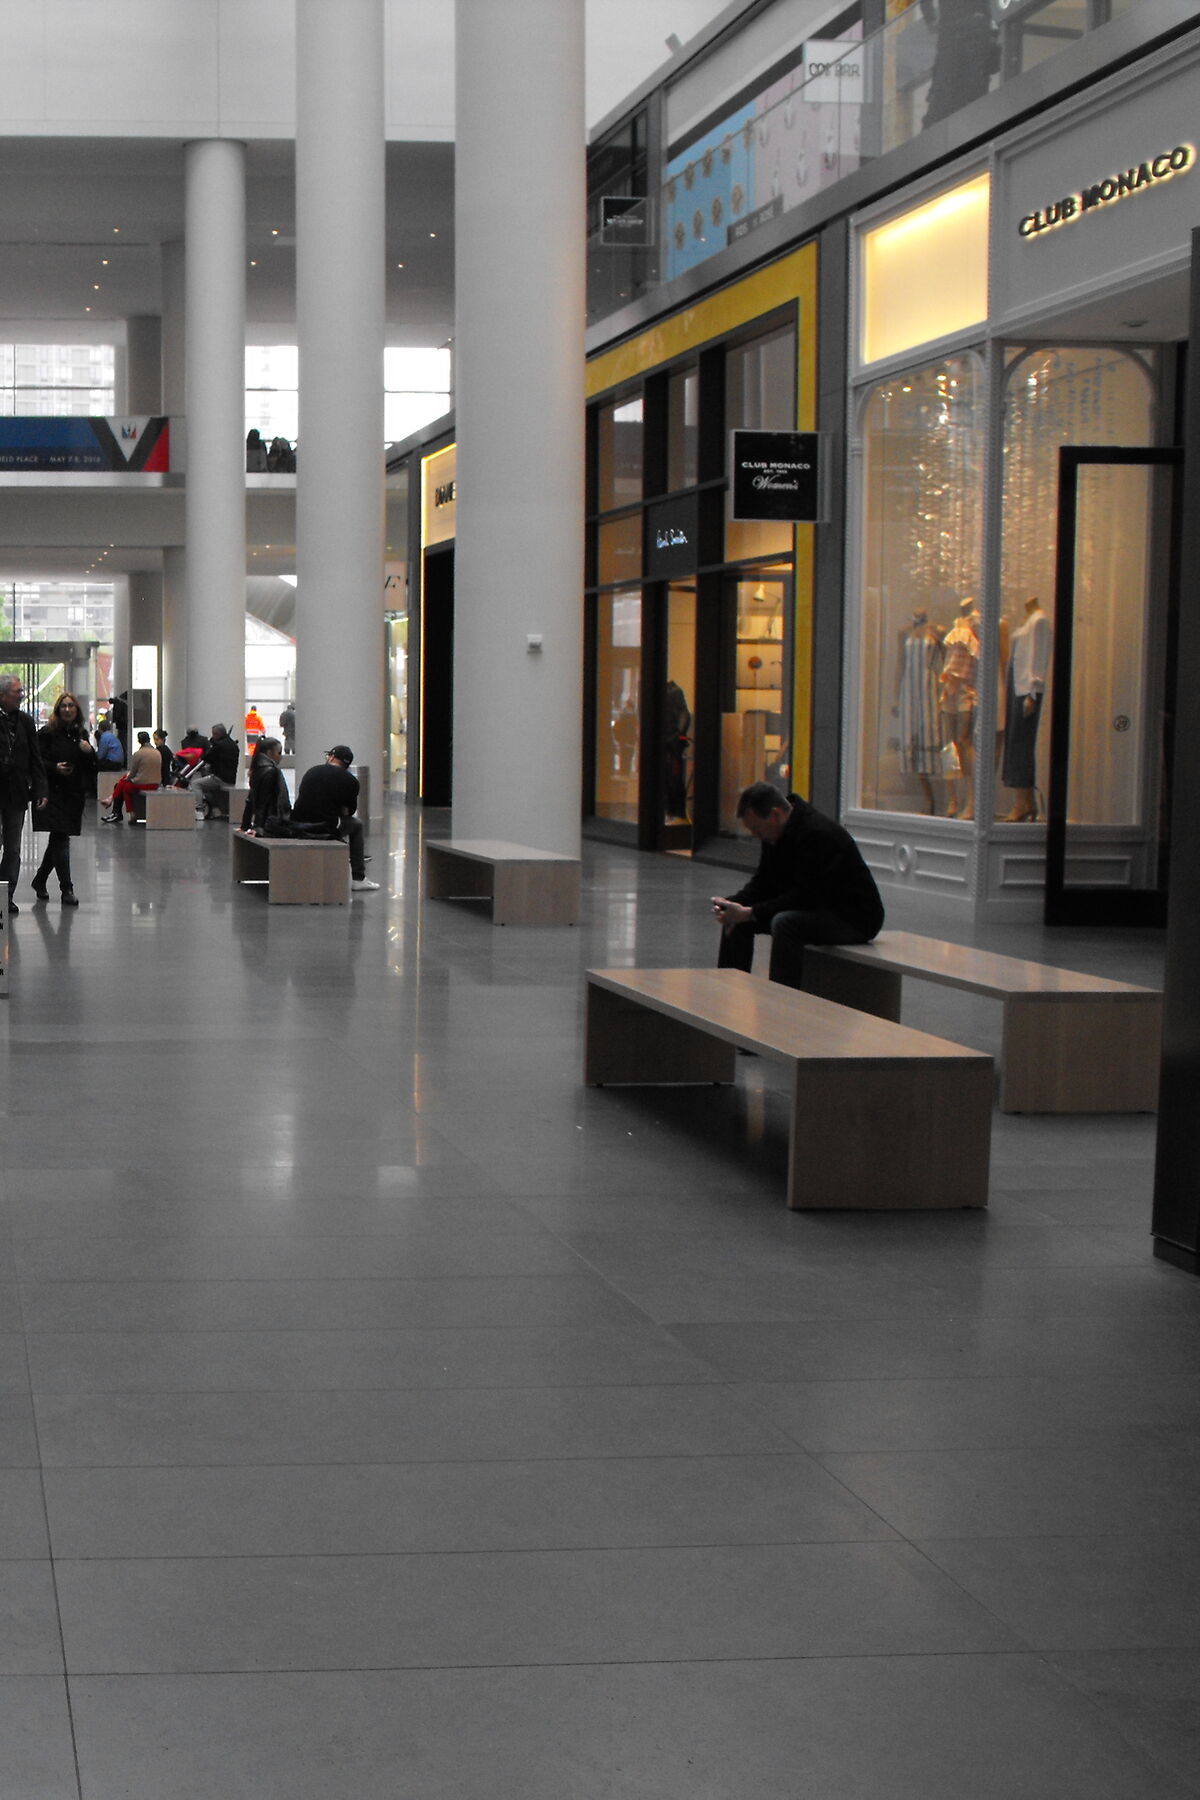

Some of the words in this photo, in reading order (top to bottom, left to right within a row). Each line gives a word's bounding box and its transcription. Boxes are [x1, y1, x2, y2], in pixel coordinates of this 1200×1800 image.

[1018, 196, 1077, 237] CLUB
[1081, 145, 1191, 212] MONACO
[16, 455, 39, 464] PLACE
[49, 455, 65, 464] MAY
[741, 461, 768, 469] CLUB
[769, 462, 811, 470] MONACO
